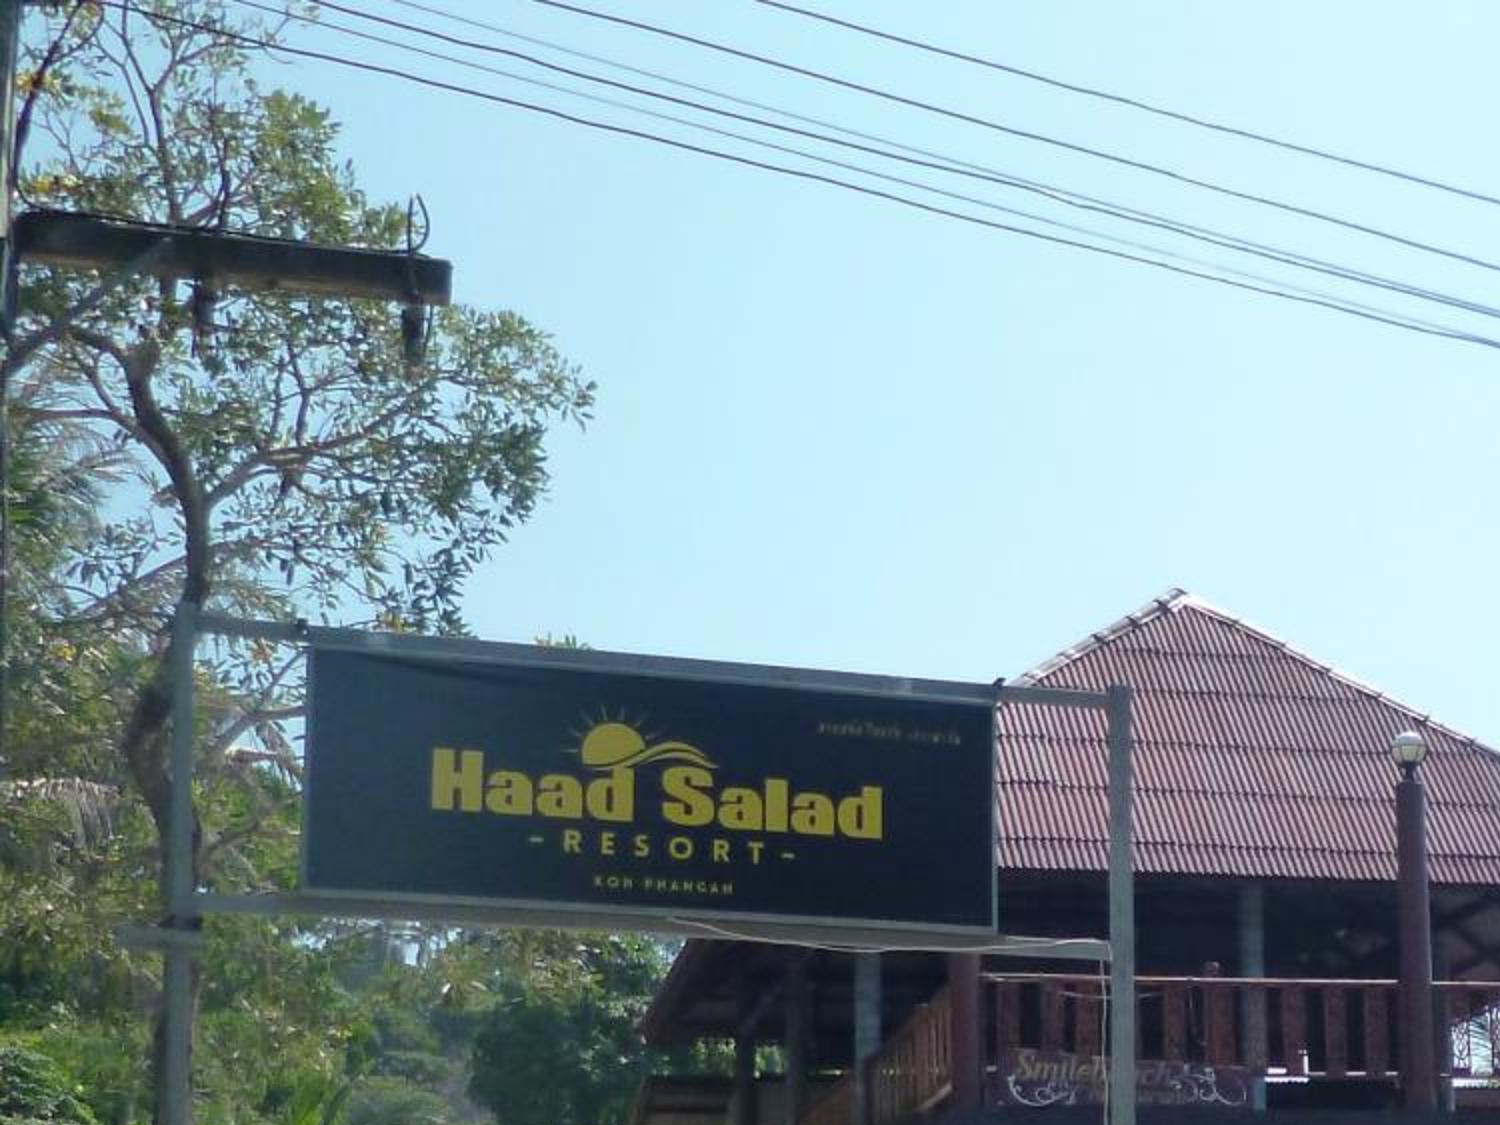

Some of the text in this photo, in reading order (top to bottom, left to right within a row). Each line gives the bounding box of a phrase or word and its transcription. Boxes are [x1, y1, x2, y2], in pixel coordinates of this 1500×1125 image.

[432, 748, 882, 840] Haad Salad
[593, 875, 634, 890] KOH
